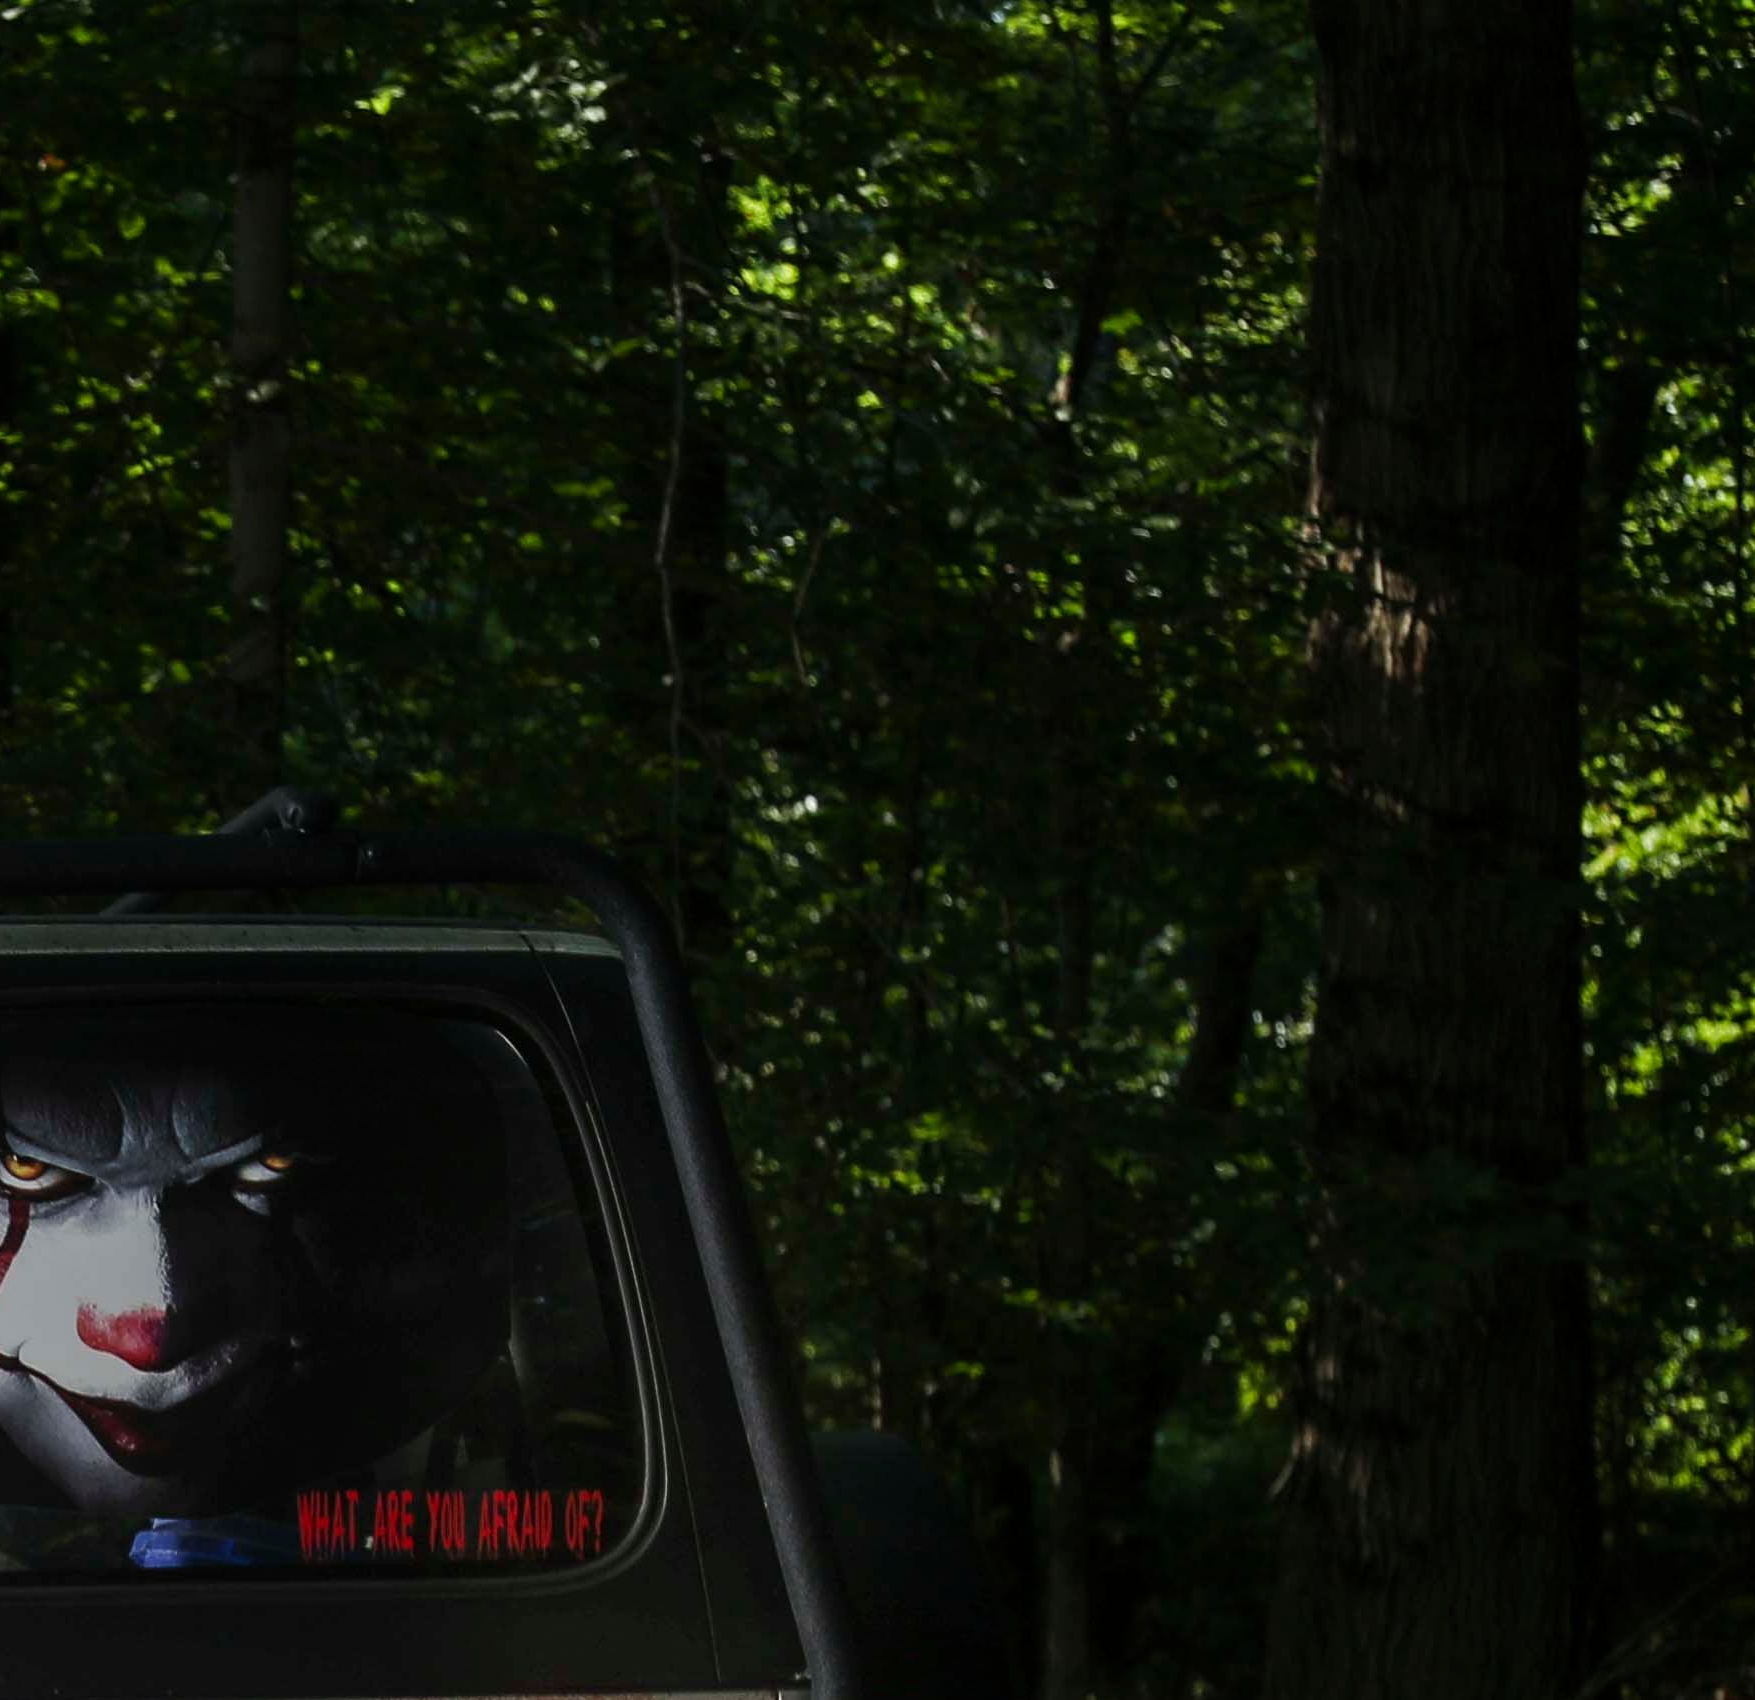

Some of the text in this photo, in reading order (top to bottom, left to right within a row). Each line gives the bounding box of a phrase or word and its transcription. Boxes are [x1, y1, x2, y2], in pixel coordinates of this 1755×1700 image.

[296, 1488, 606, 1561] WHAT ARE YOU AFRAID OF?
